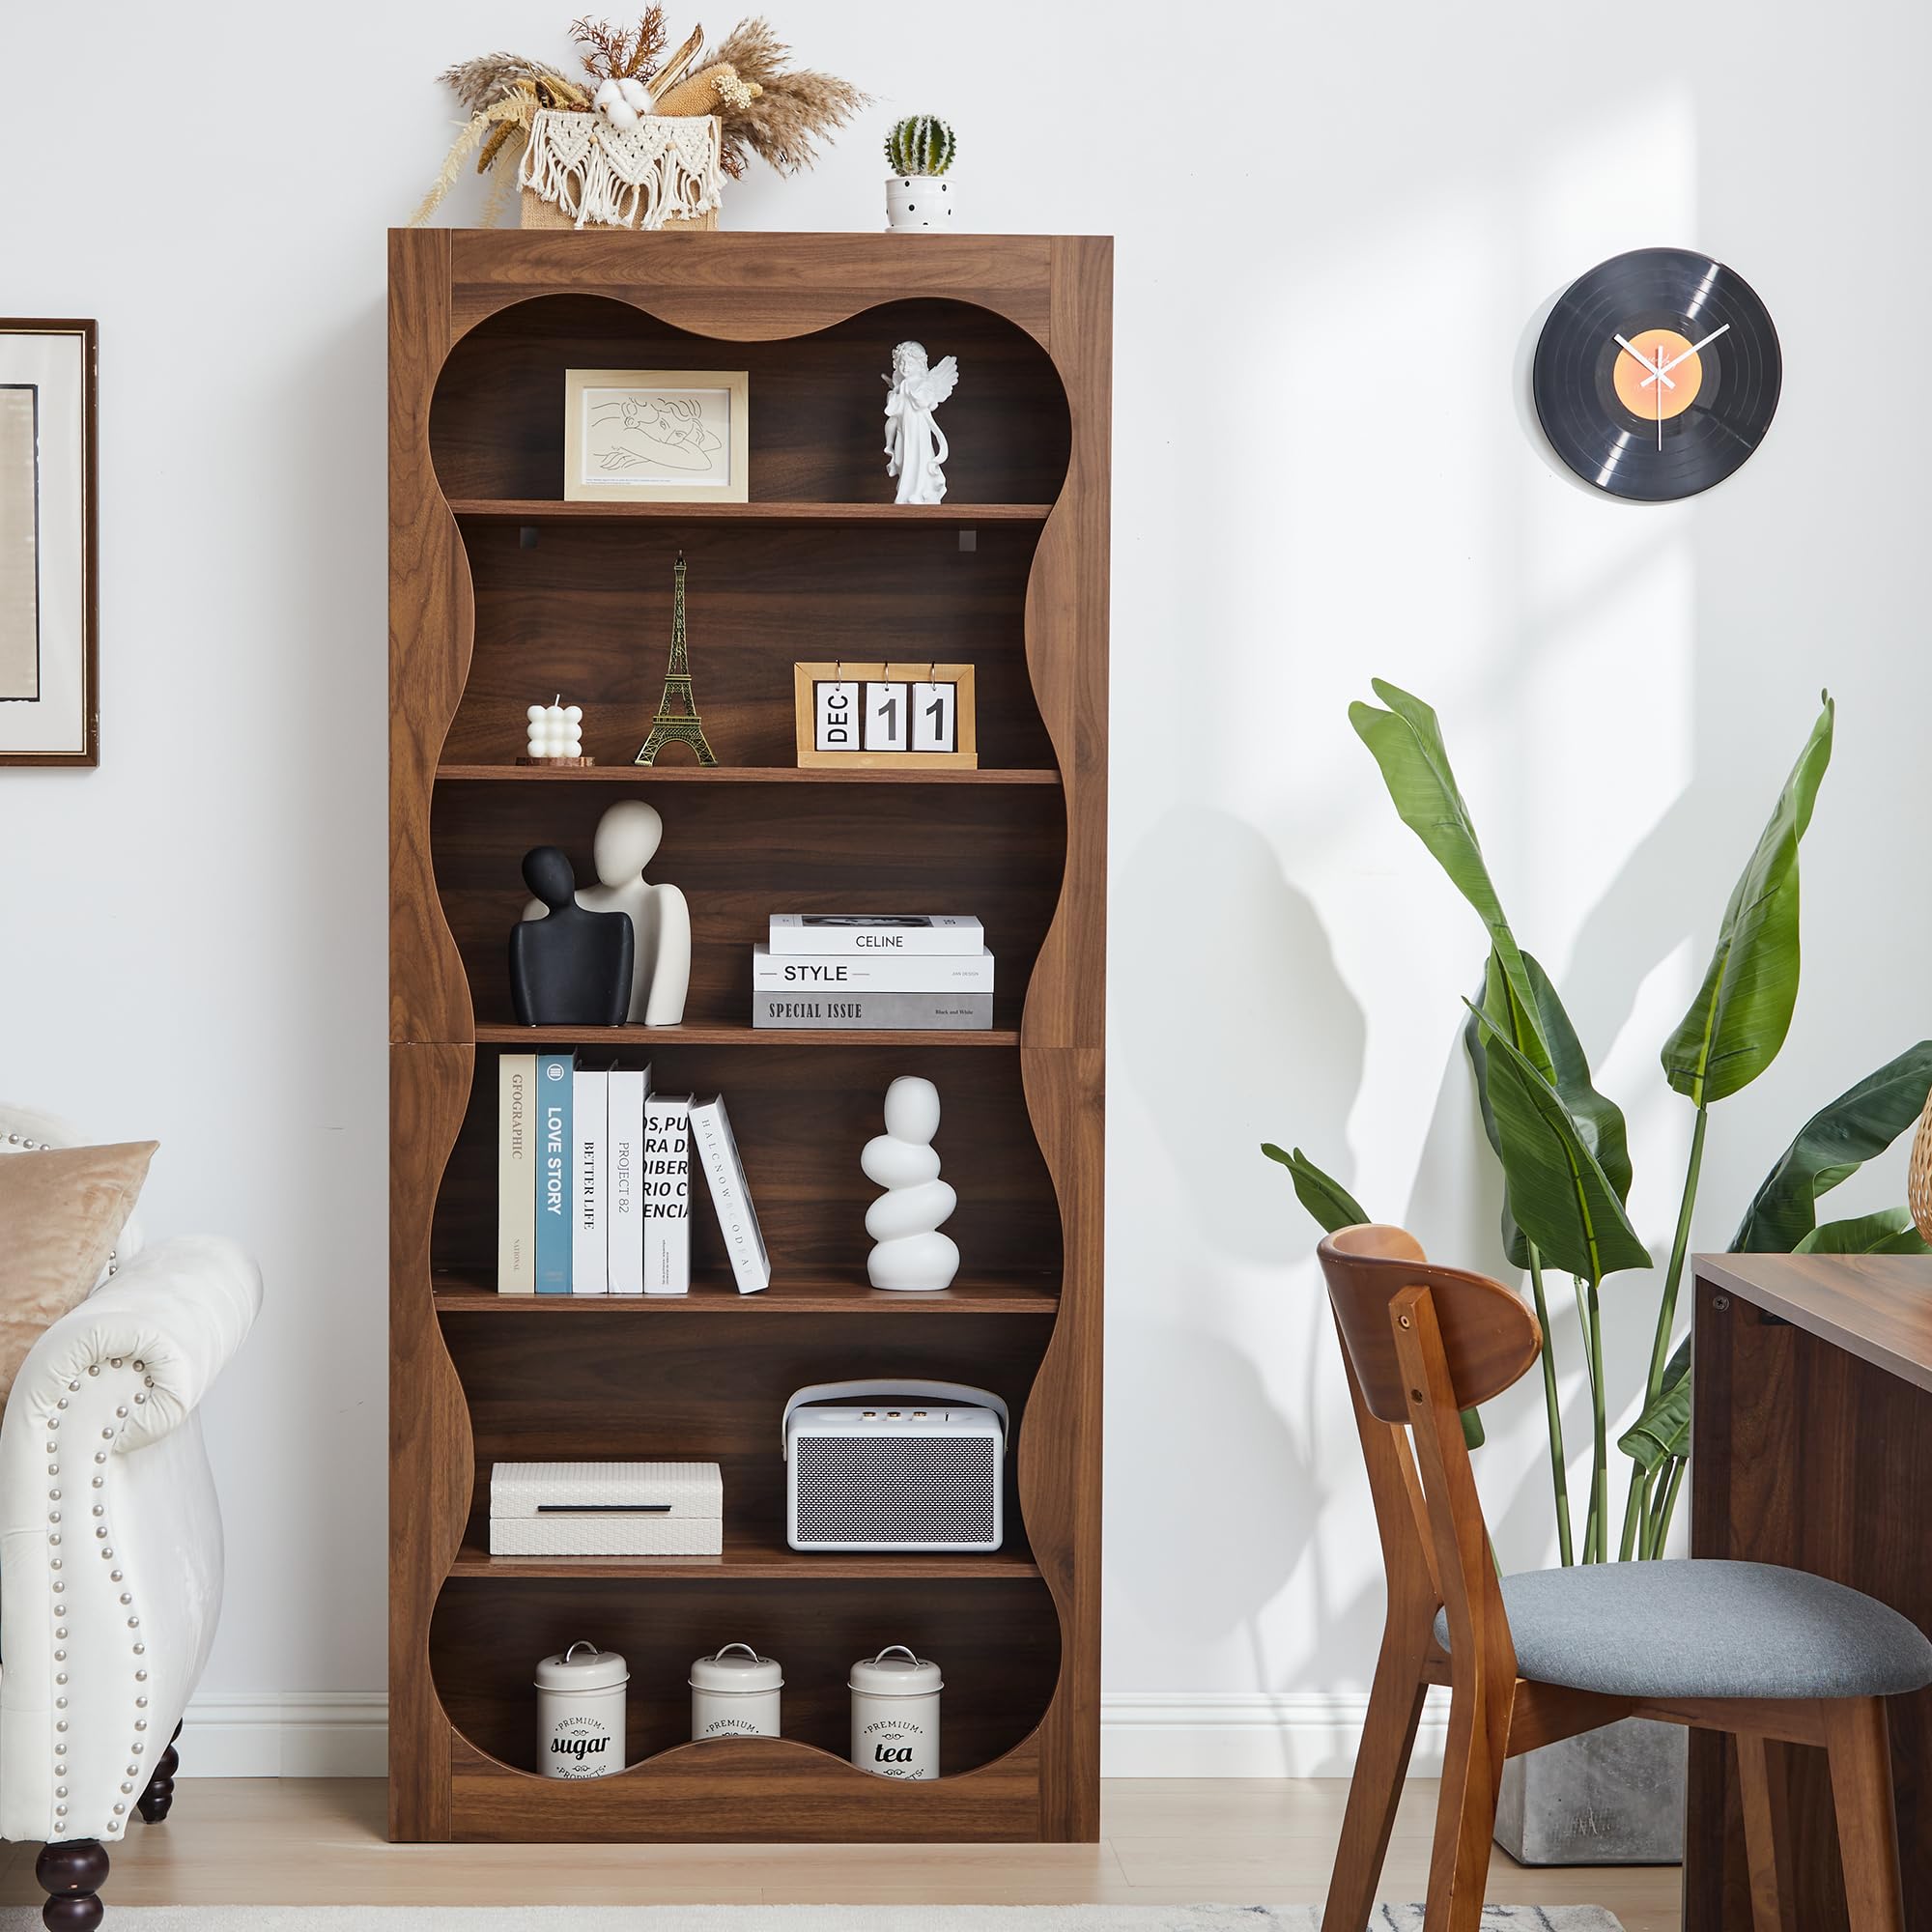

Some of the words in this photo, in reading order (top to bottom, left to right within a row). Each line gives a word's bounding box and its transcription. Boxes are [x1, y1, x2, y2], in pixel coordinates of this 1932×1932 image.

[828, 695, 848, 742] DEC
[855, 935, 903, 948] CELINE
[783, 965, 848, 981] STYLE
[769, 1003, 822, 1018] SPECIAL
[828, 1003, 862, 1018] ISSUE
[548, 1107, 562, 1153] LOVE
[645, 1138, 668, 1152] RA
[583, 1142, 595, 1195] BETTER
[617, 1142, 630, 1196] PROJECT
[548, 1158, 562, 1215] STORY
[583, 1199, 595, 1230] LIFE
[618, 1199, 630, 1213] 82
[557, 1717, 602, 1730] PREMIUM
[708, 1719, 755, 1732] PREMIUM
[867, 1720, 920, 1733] PREMIUM
[550, 1736, 611, 1761] sugar
[874, 1744, 913, 1763] tea
